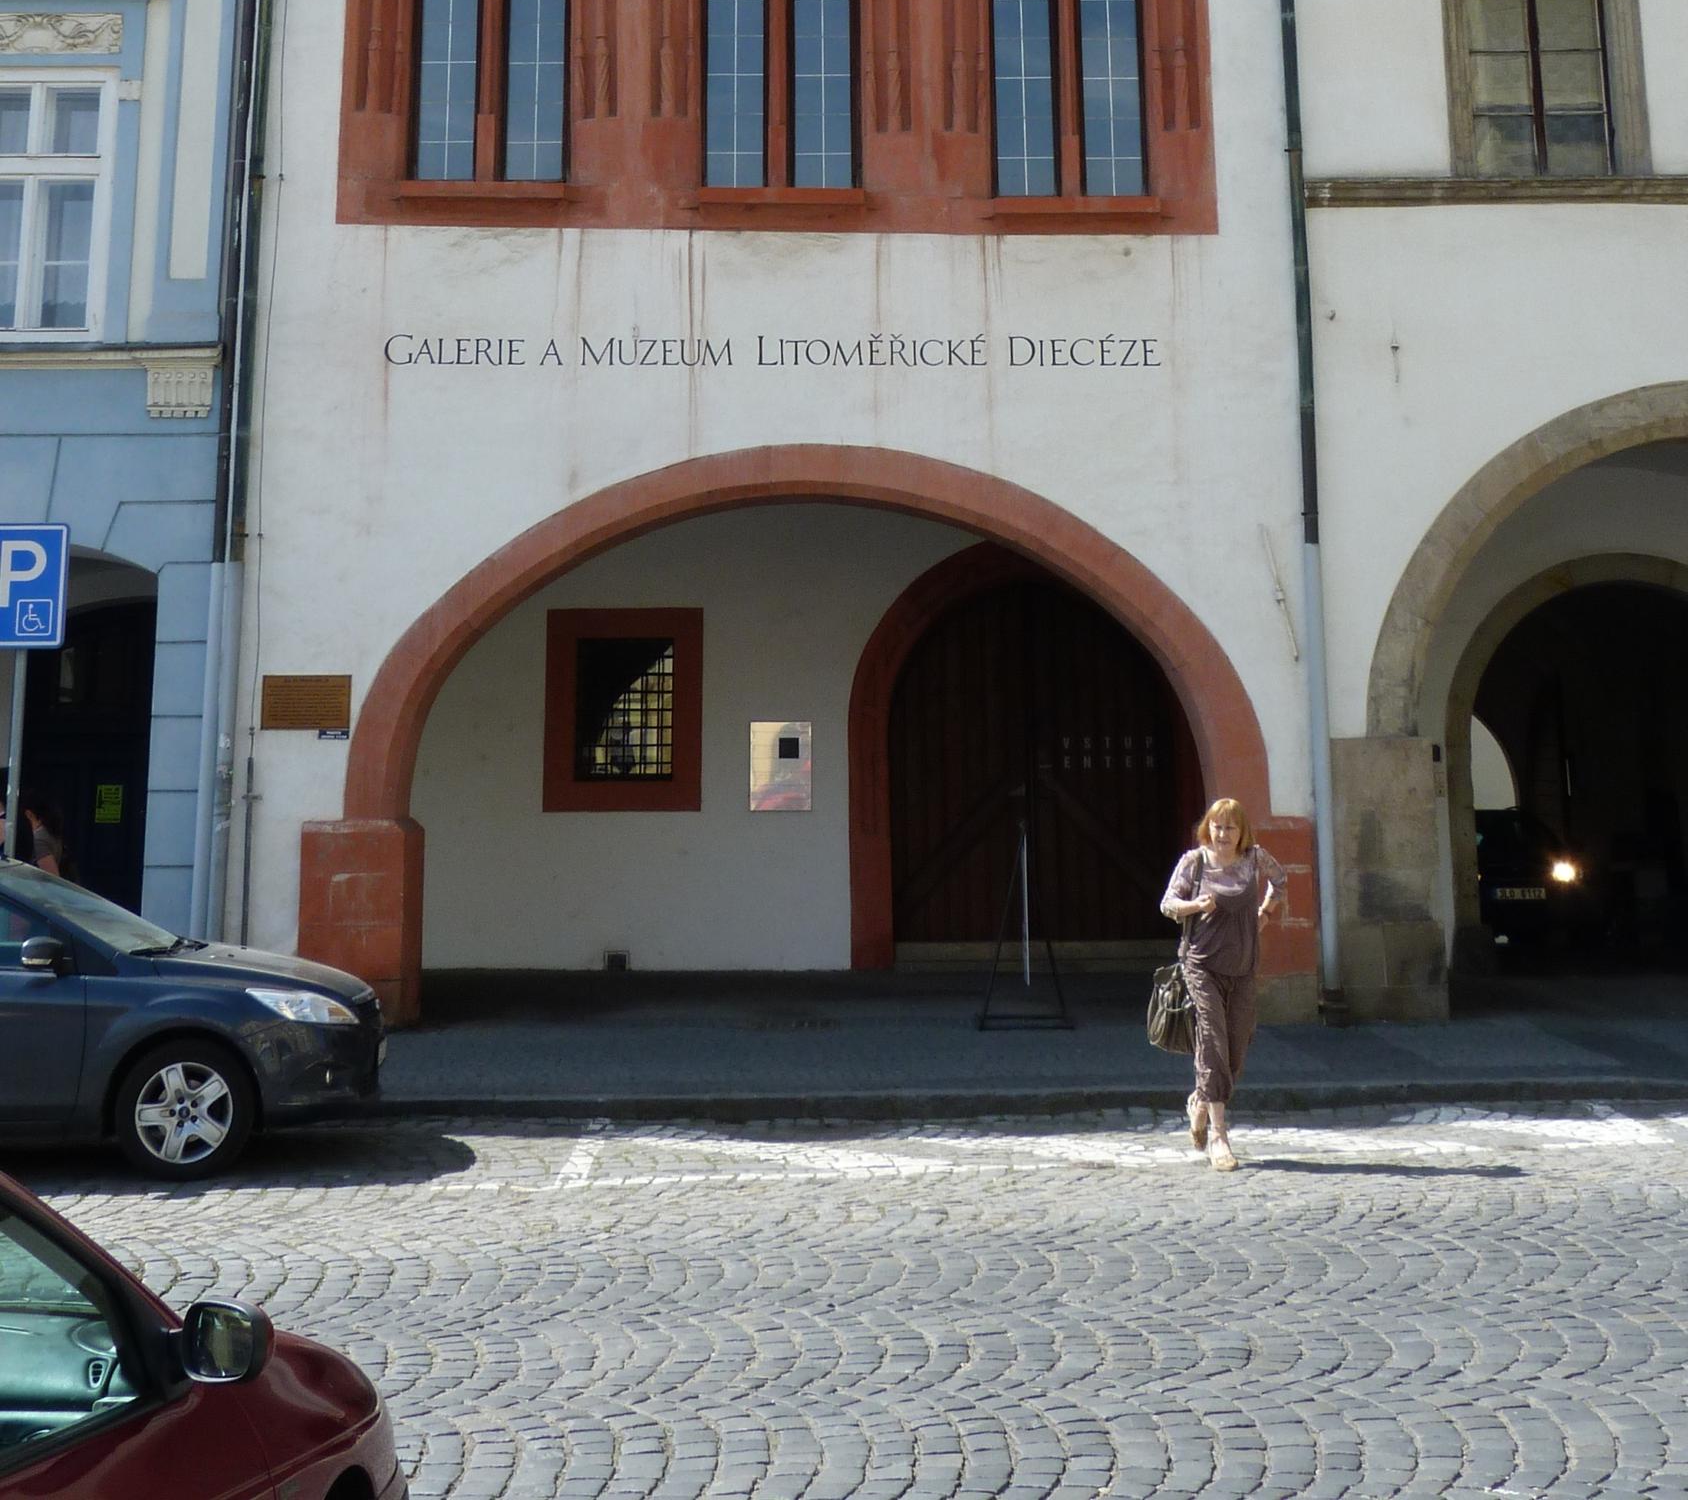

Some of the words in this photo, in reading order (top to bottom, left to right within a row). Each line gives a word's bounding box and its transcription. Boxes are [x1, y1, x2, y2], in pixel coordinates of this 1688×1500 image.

[383, 334, 526, 367] GALERIE
[539, 338, 564, 367] A
[580, 336, 735, 367] MUZEUM
[757, 332, 988, 368] LITOMĚŘICKÉ
[1007, 333, 1162, 368] DIECÉZE
[0, 540, 47, 608] P
[1062, 736, 1153, 749] VSTUP
[1063, 755, 1154, 769] ENTER
